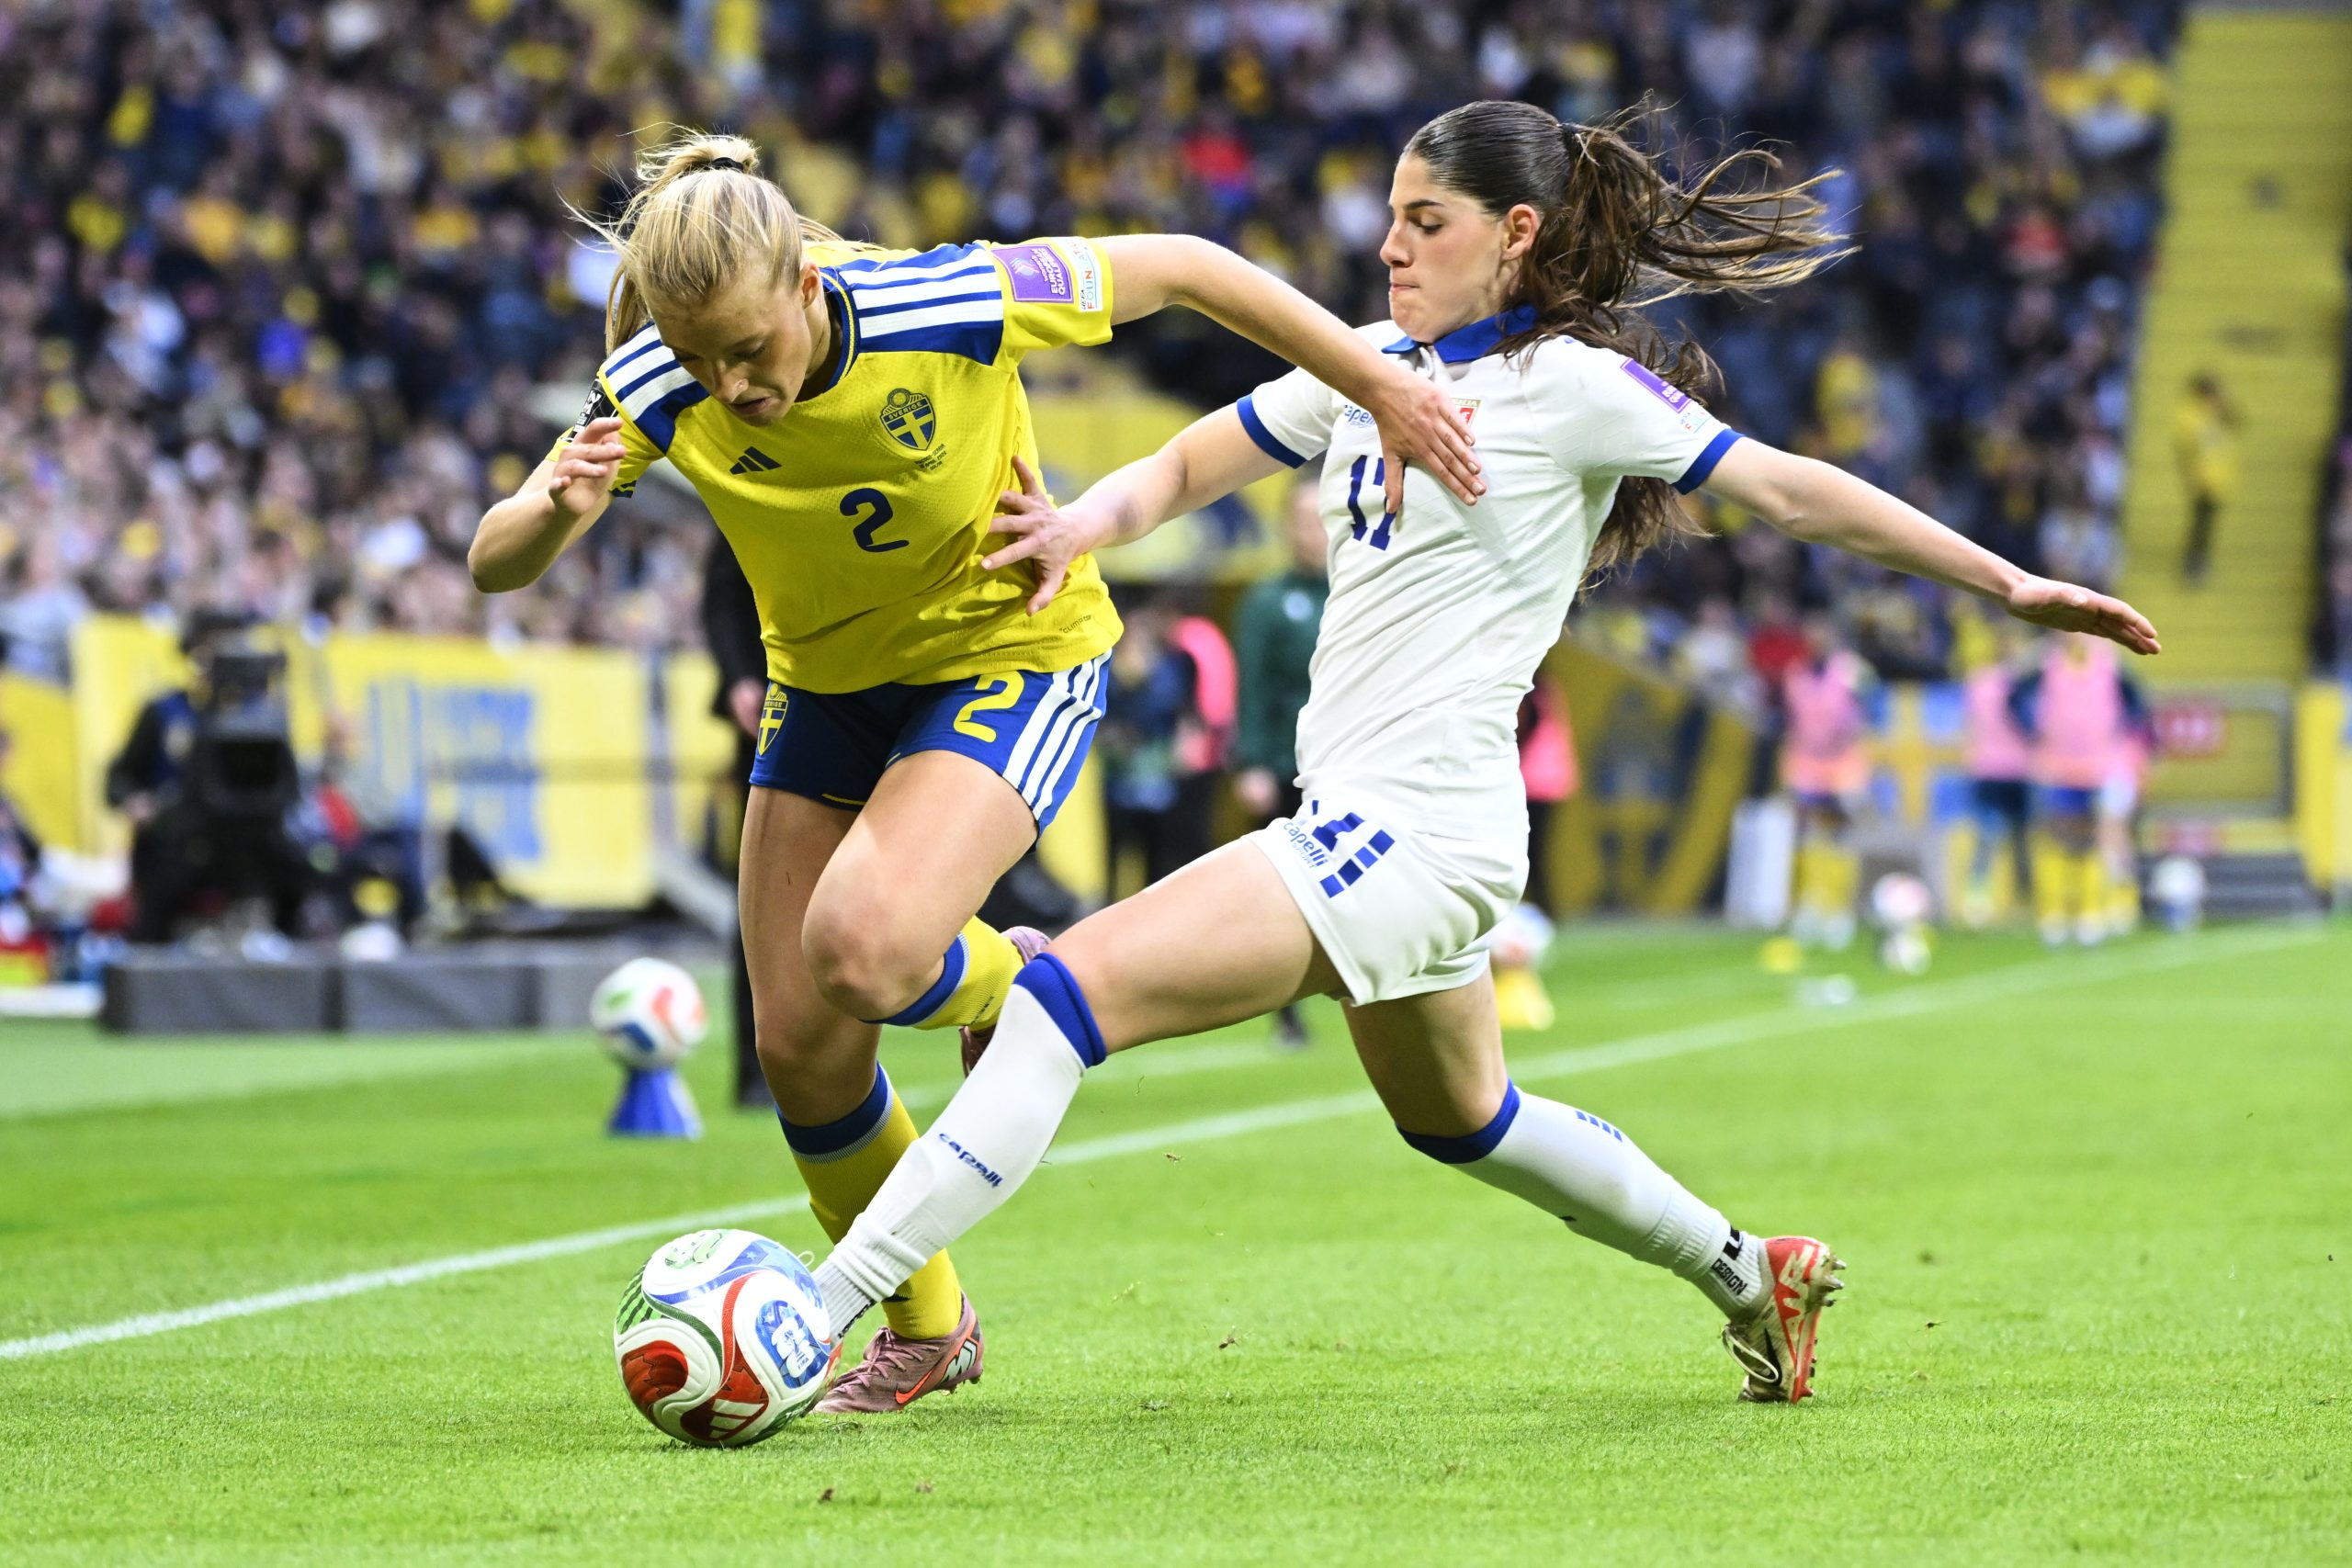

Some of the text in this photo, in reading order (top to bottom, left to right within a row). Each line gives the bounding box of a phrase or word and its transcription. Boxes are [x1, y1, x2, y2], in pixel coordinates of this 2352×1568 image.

[888, 401, 923, 421] SVERIGE
[1344, 404, 1375, 425] apell
[840, 488, 910, 552] 2
[954, 670, 1024, 743] 2
[1283, 822, 1329, 867] capelli
[1710, 1258, 1748, 1295] DESIGN
